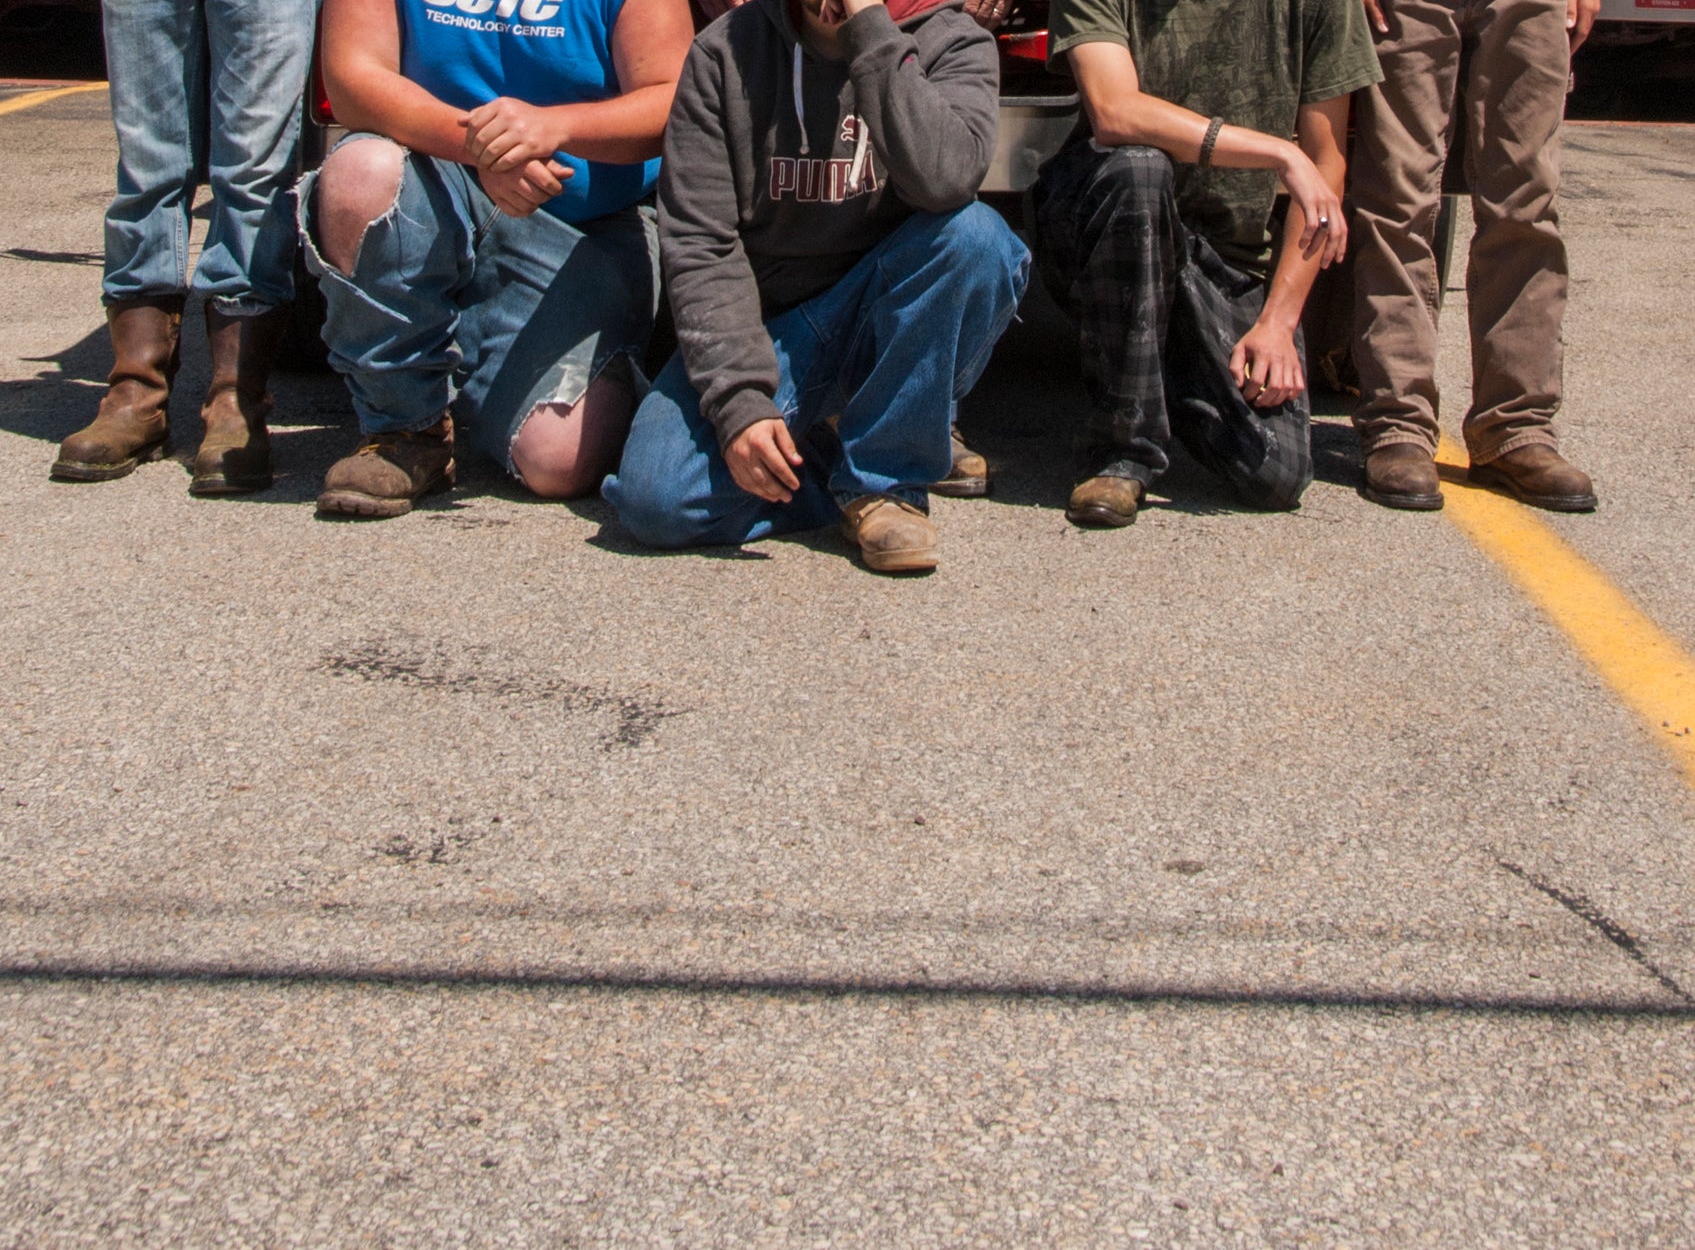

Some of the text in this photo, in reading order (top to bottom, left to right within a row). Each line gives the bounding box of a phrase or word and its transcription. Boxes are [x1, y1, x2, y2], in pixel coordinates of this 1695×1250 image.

[425, 8, 565, 38] TECHNOLOGY CENTER
[769, 150, 878, 203] PUMA
